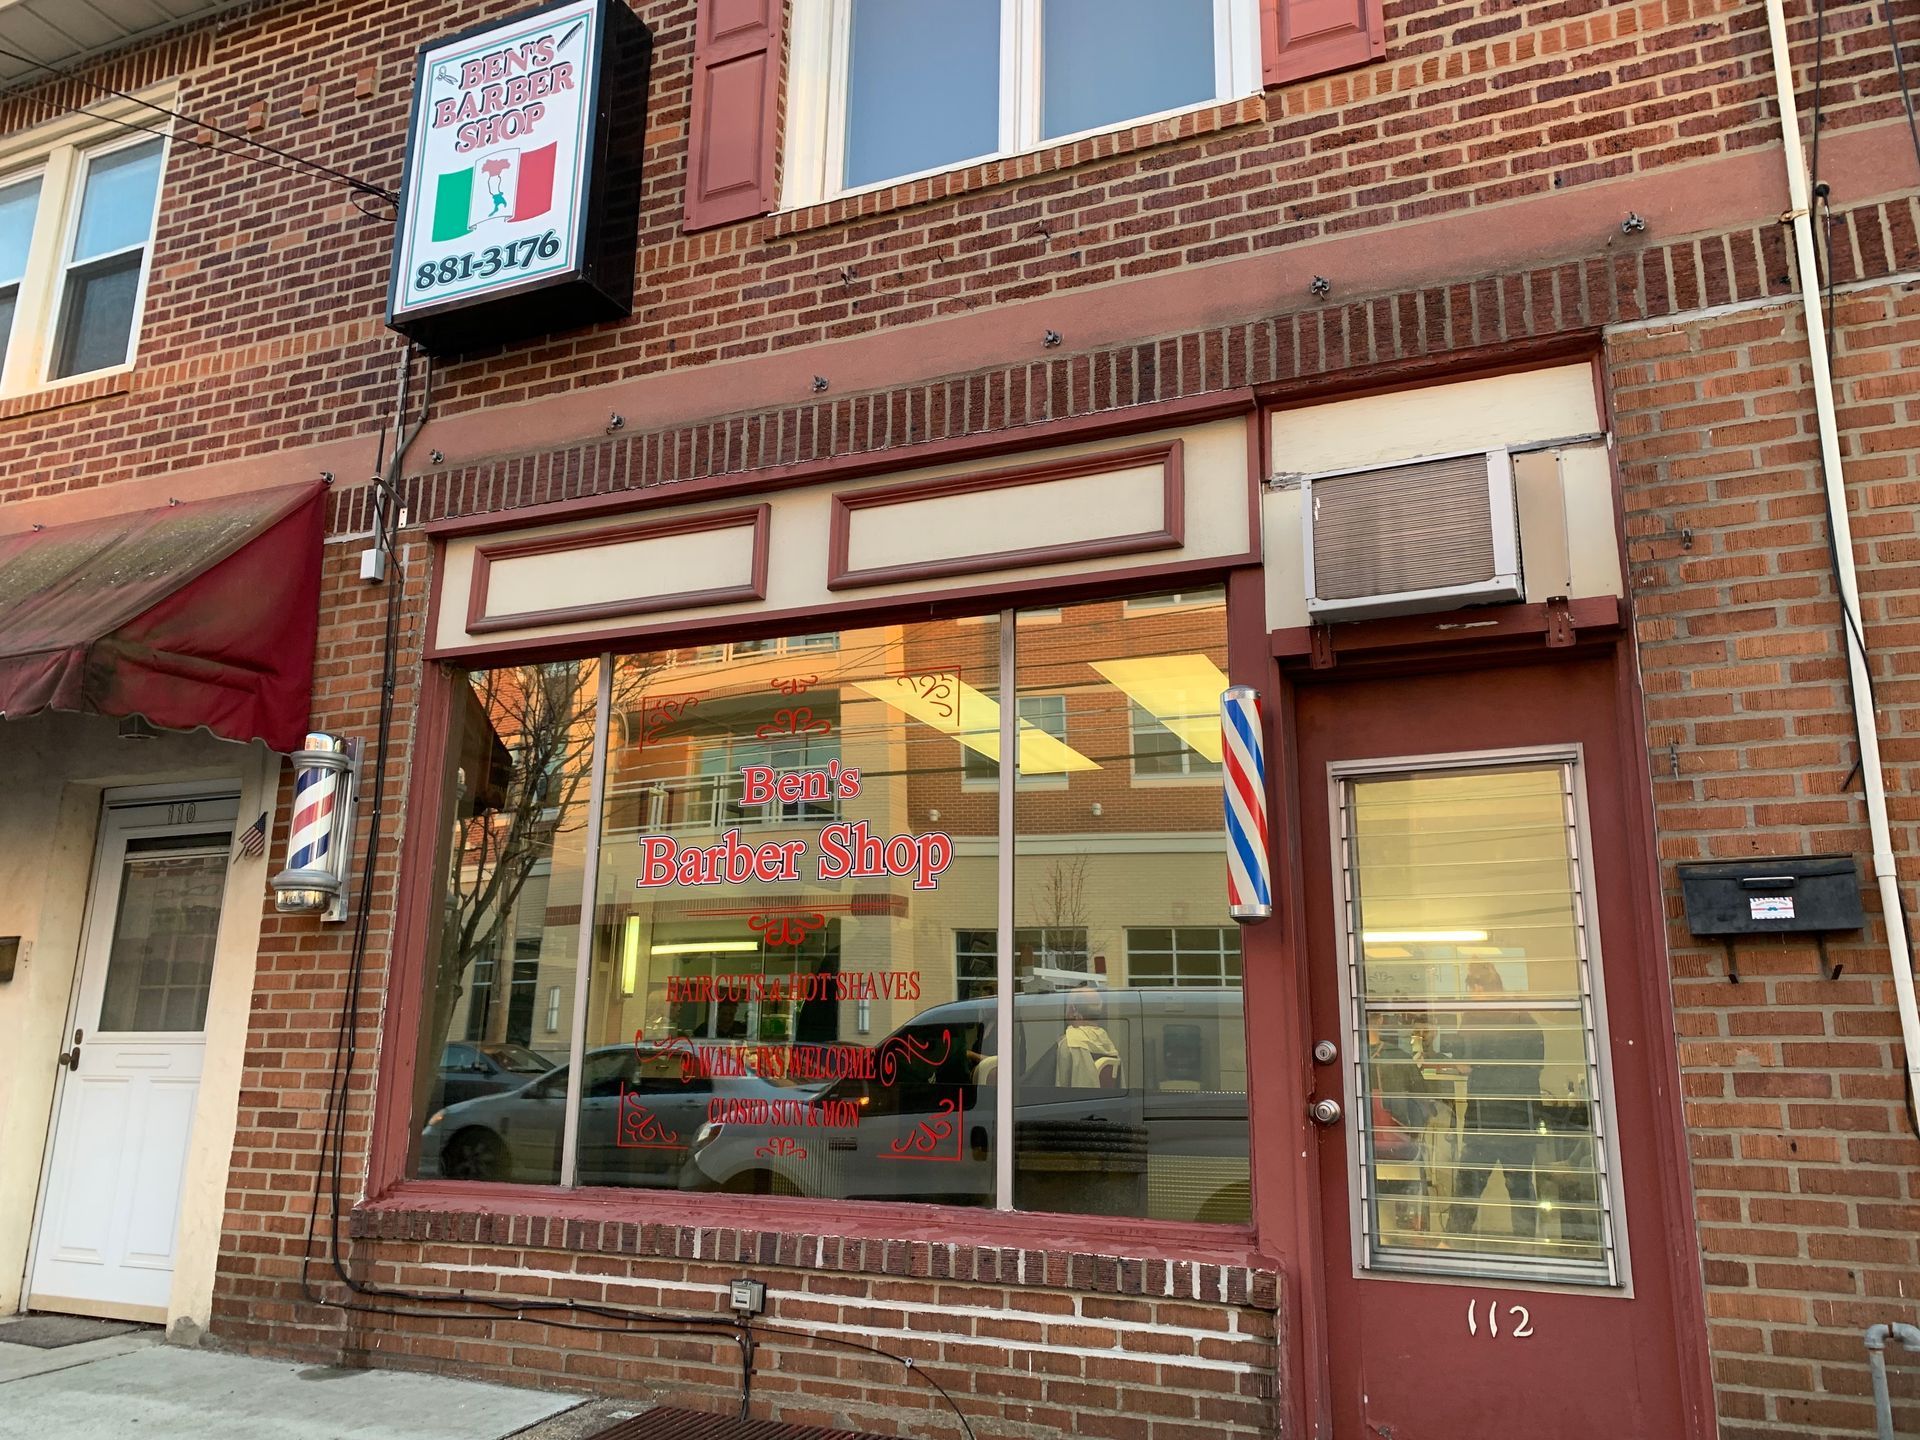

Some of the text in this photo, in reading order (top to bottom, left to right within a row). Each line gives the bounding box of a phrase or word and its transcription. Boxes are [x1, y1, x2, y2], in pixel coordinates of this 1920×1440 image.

[458, 35, 557, 91] BEN'S
[432, 61, 575, 129] BARBER
[455, 102, 546, 153] SHOP
[414, 229, 562, 291] 881-3176
[739, 758, 862, 807] Ben's
[167, 802, 196, 825] 110
[636, 819, 956, 890] Barber Shop
[665, 971, 921, 1002] HAIRCUTS & HOT SHAVES
[788, 1046, 877, 1079] WELCOME
[708, 1097, 860, 1128] CLOSED SUN & MON
[1467, 1298, 1534, 1338] 112
